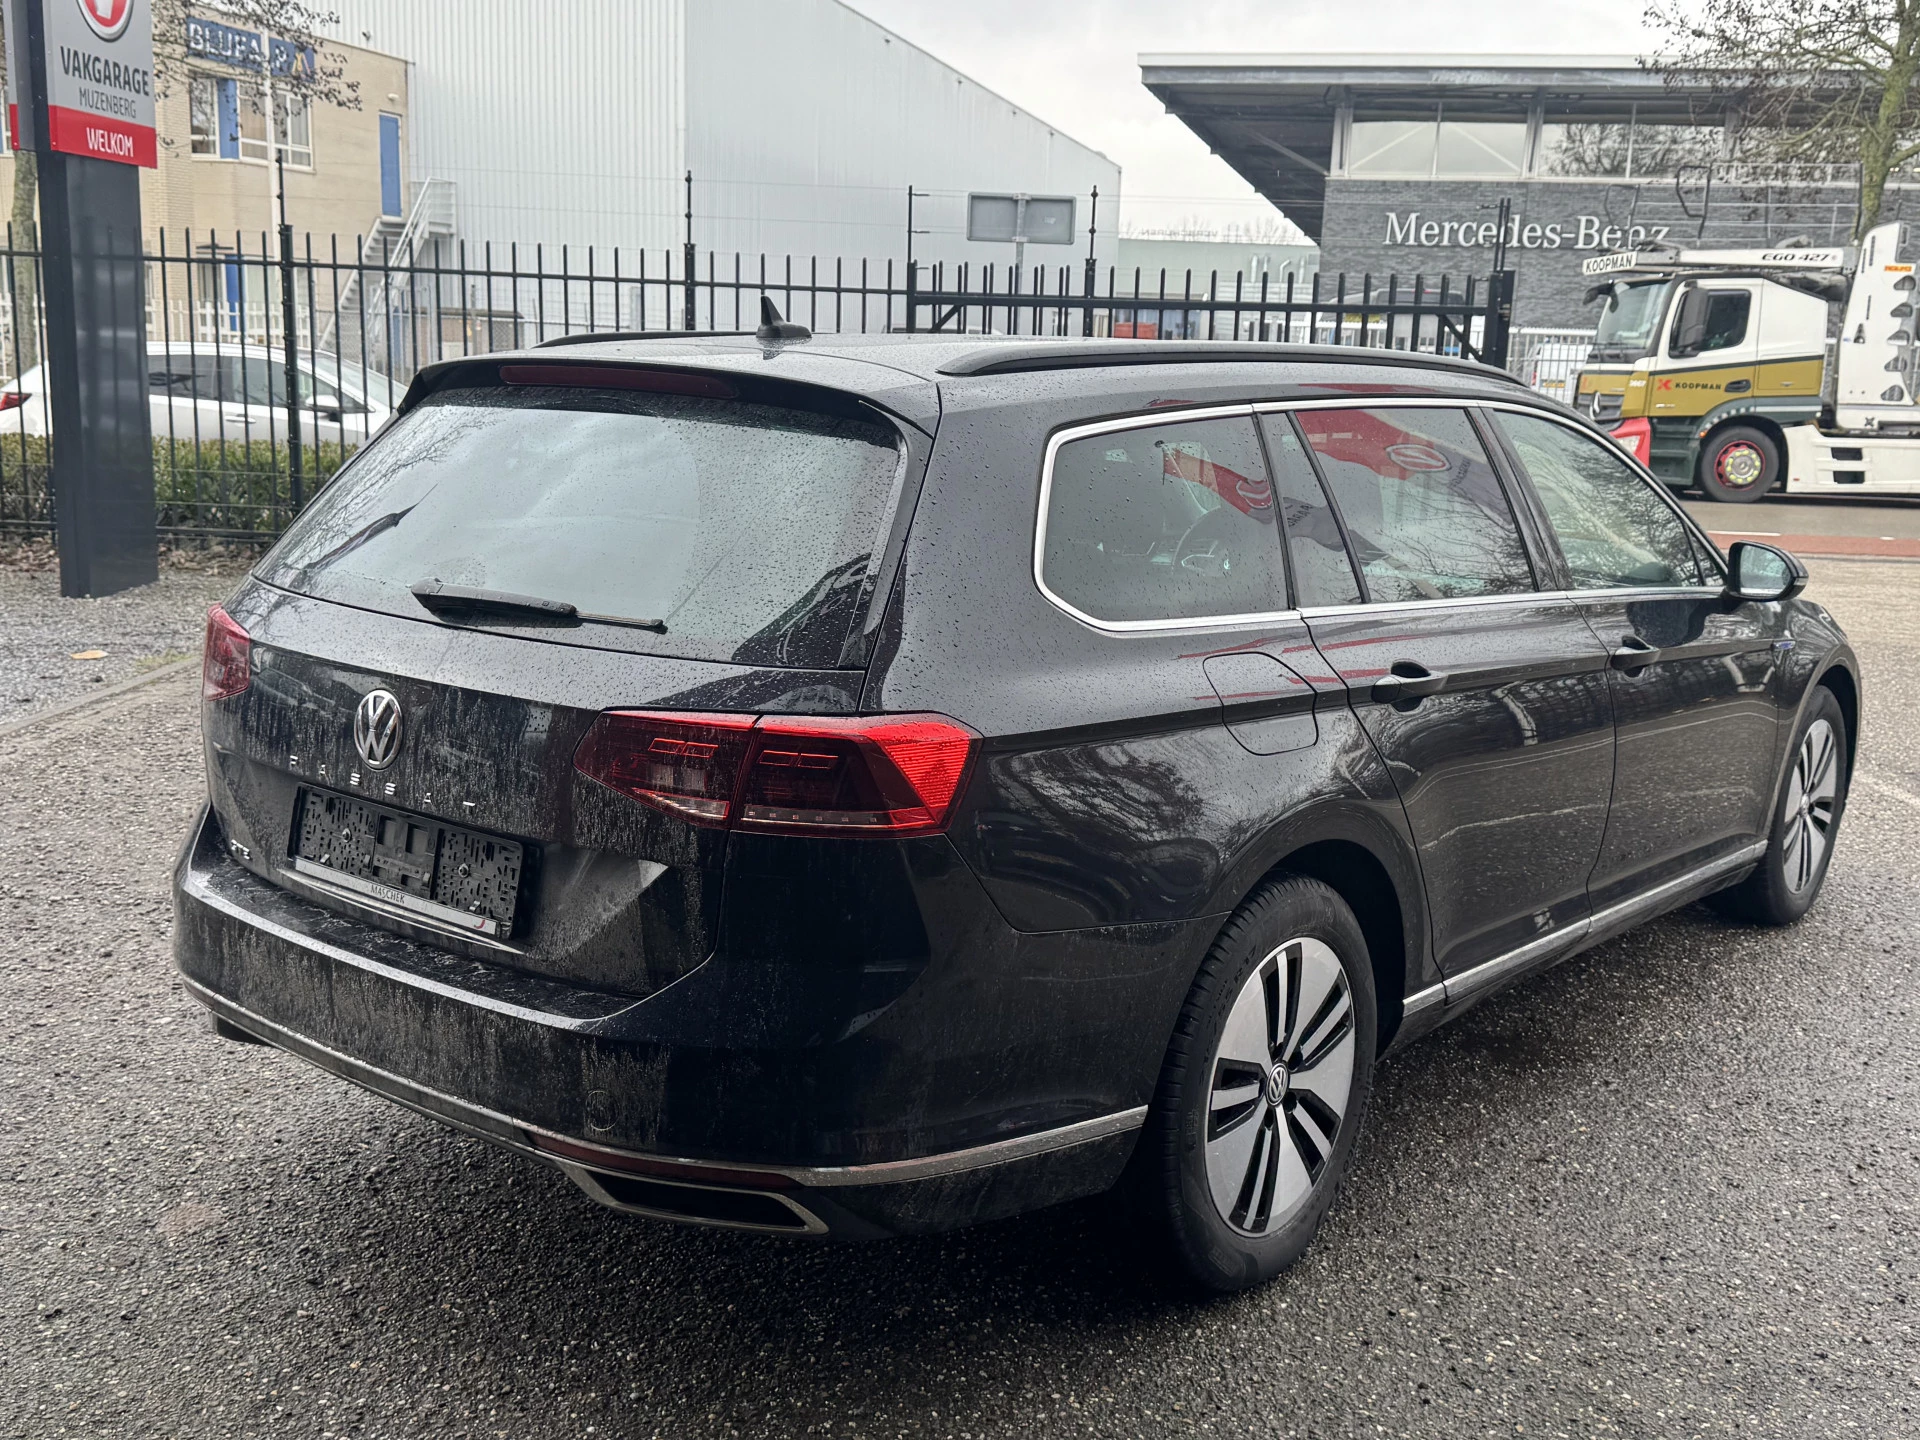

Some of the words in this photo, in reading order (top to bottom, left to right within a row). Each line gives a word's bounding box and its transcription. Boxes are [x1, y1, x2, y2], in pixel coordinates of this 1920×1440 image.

[60, 46, 150, 96] VAKGARAGE
[79, 87, 136, 119] MUZENBERG
[86, 127, 134, 157] WELKOM
[1382, 212, 1670, 250] Mercedes-Benz
[1585, 253, 1634, 274] KOOPMAN
[1762, 252, 1796, 261] EGO
[1799, 253, 1831, 262] 427
[1675, 382, 1722, 390] KOOPMAN
[289, 754, 476, 814] PASSAT
[370, 884, 405, 905] MASCHEK
